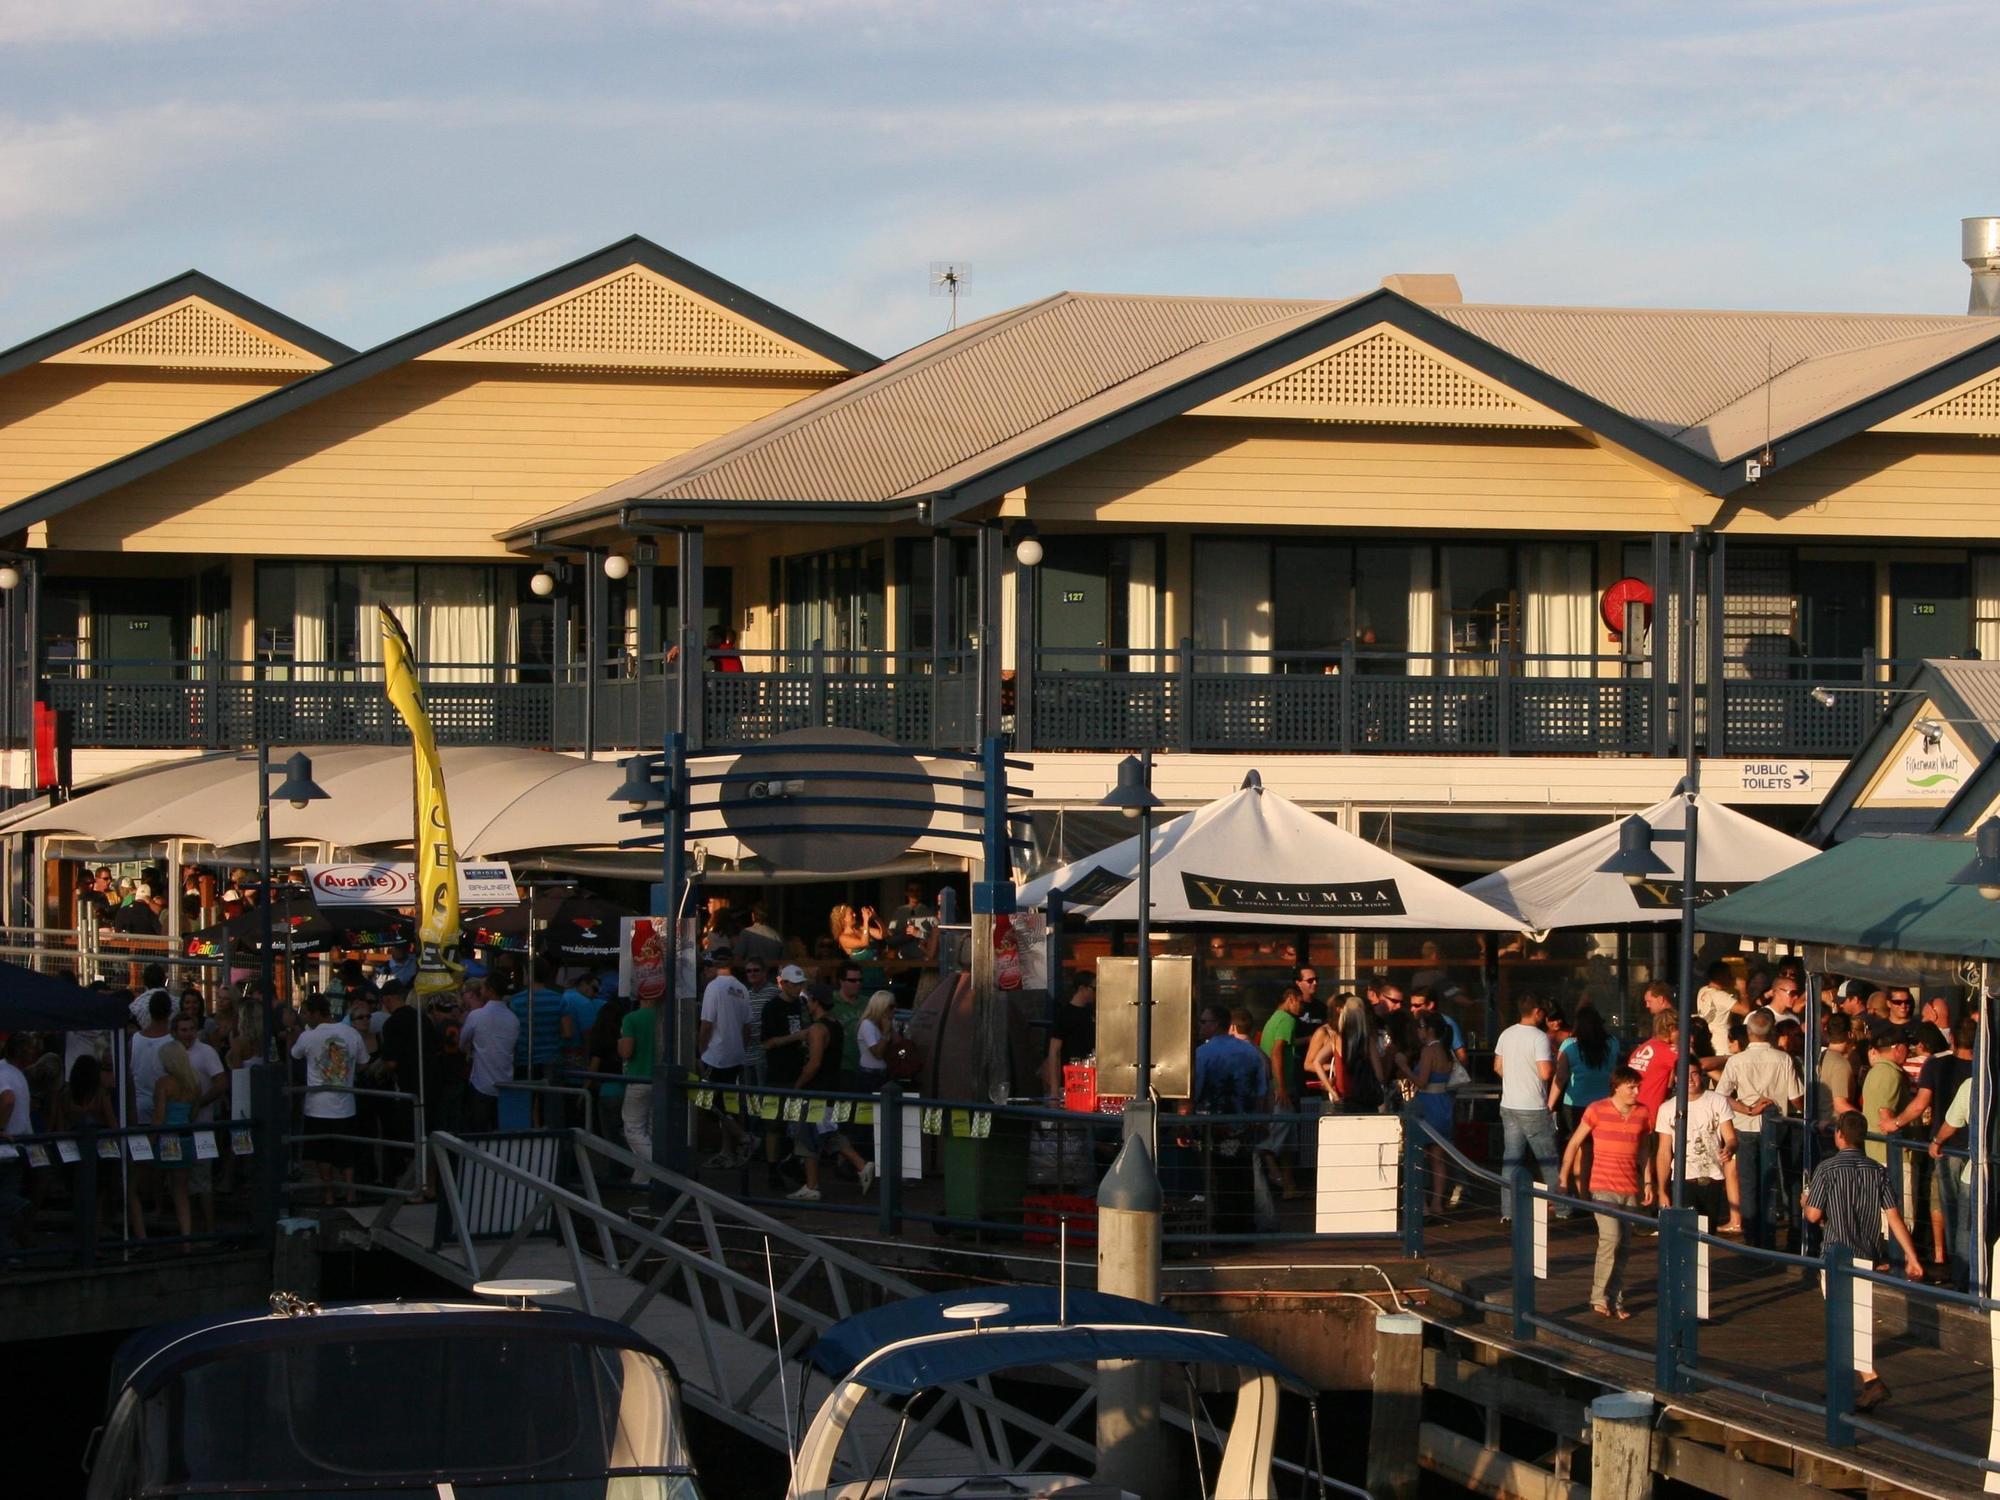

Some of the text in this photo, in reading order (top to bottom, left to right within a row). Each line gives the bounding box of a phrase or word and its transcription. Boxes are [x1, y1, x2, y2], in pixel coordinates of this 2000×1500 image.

[1068, 593, 1084, 601] 127
[1918, 605, 1935, 614] 128
[1744, 764, 1788, 776] PUBLIC
[1742, 778, 1792, 790] TOILETS
[324, 875, 389, 888] Avante
[1231, 887, 1389, 903] YALUMBA
